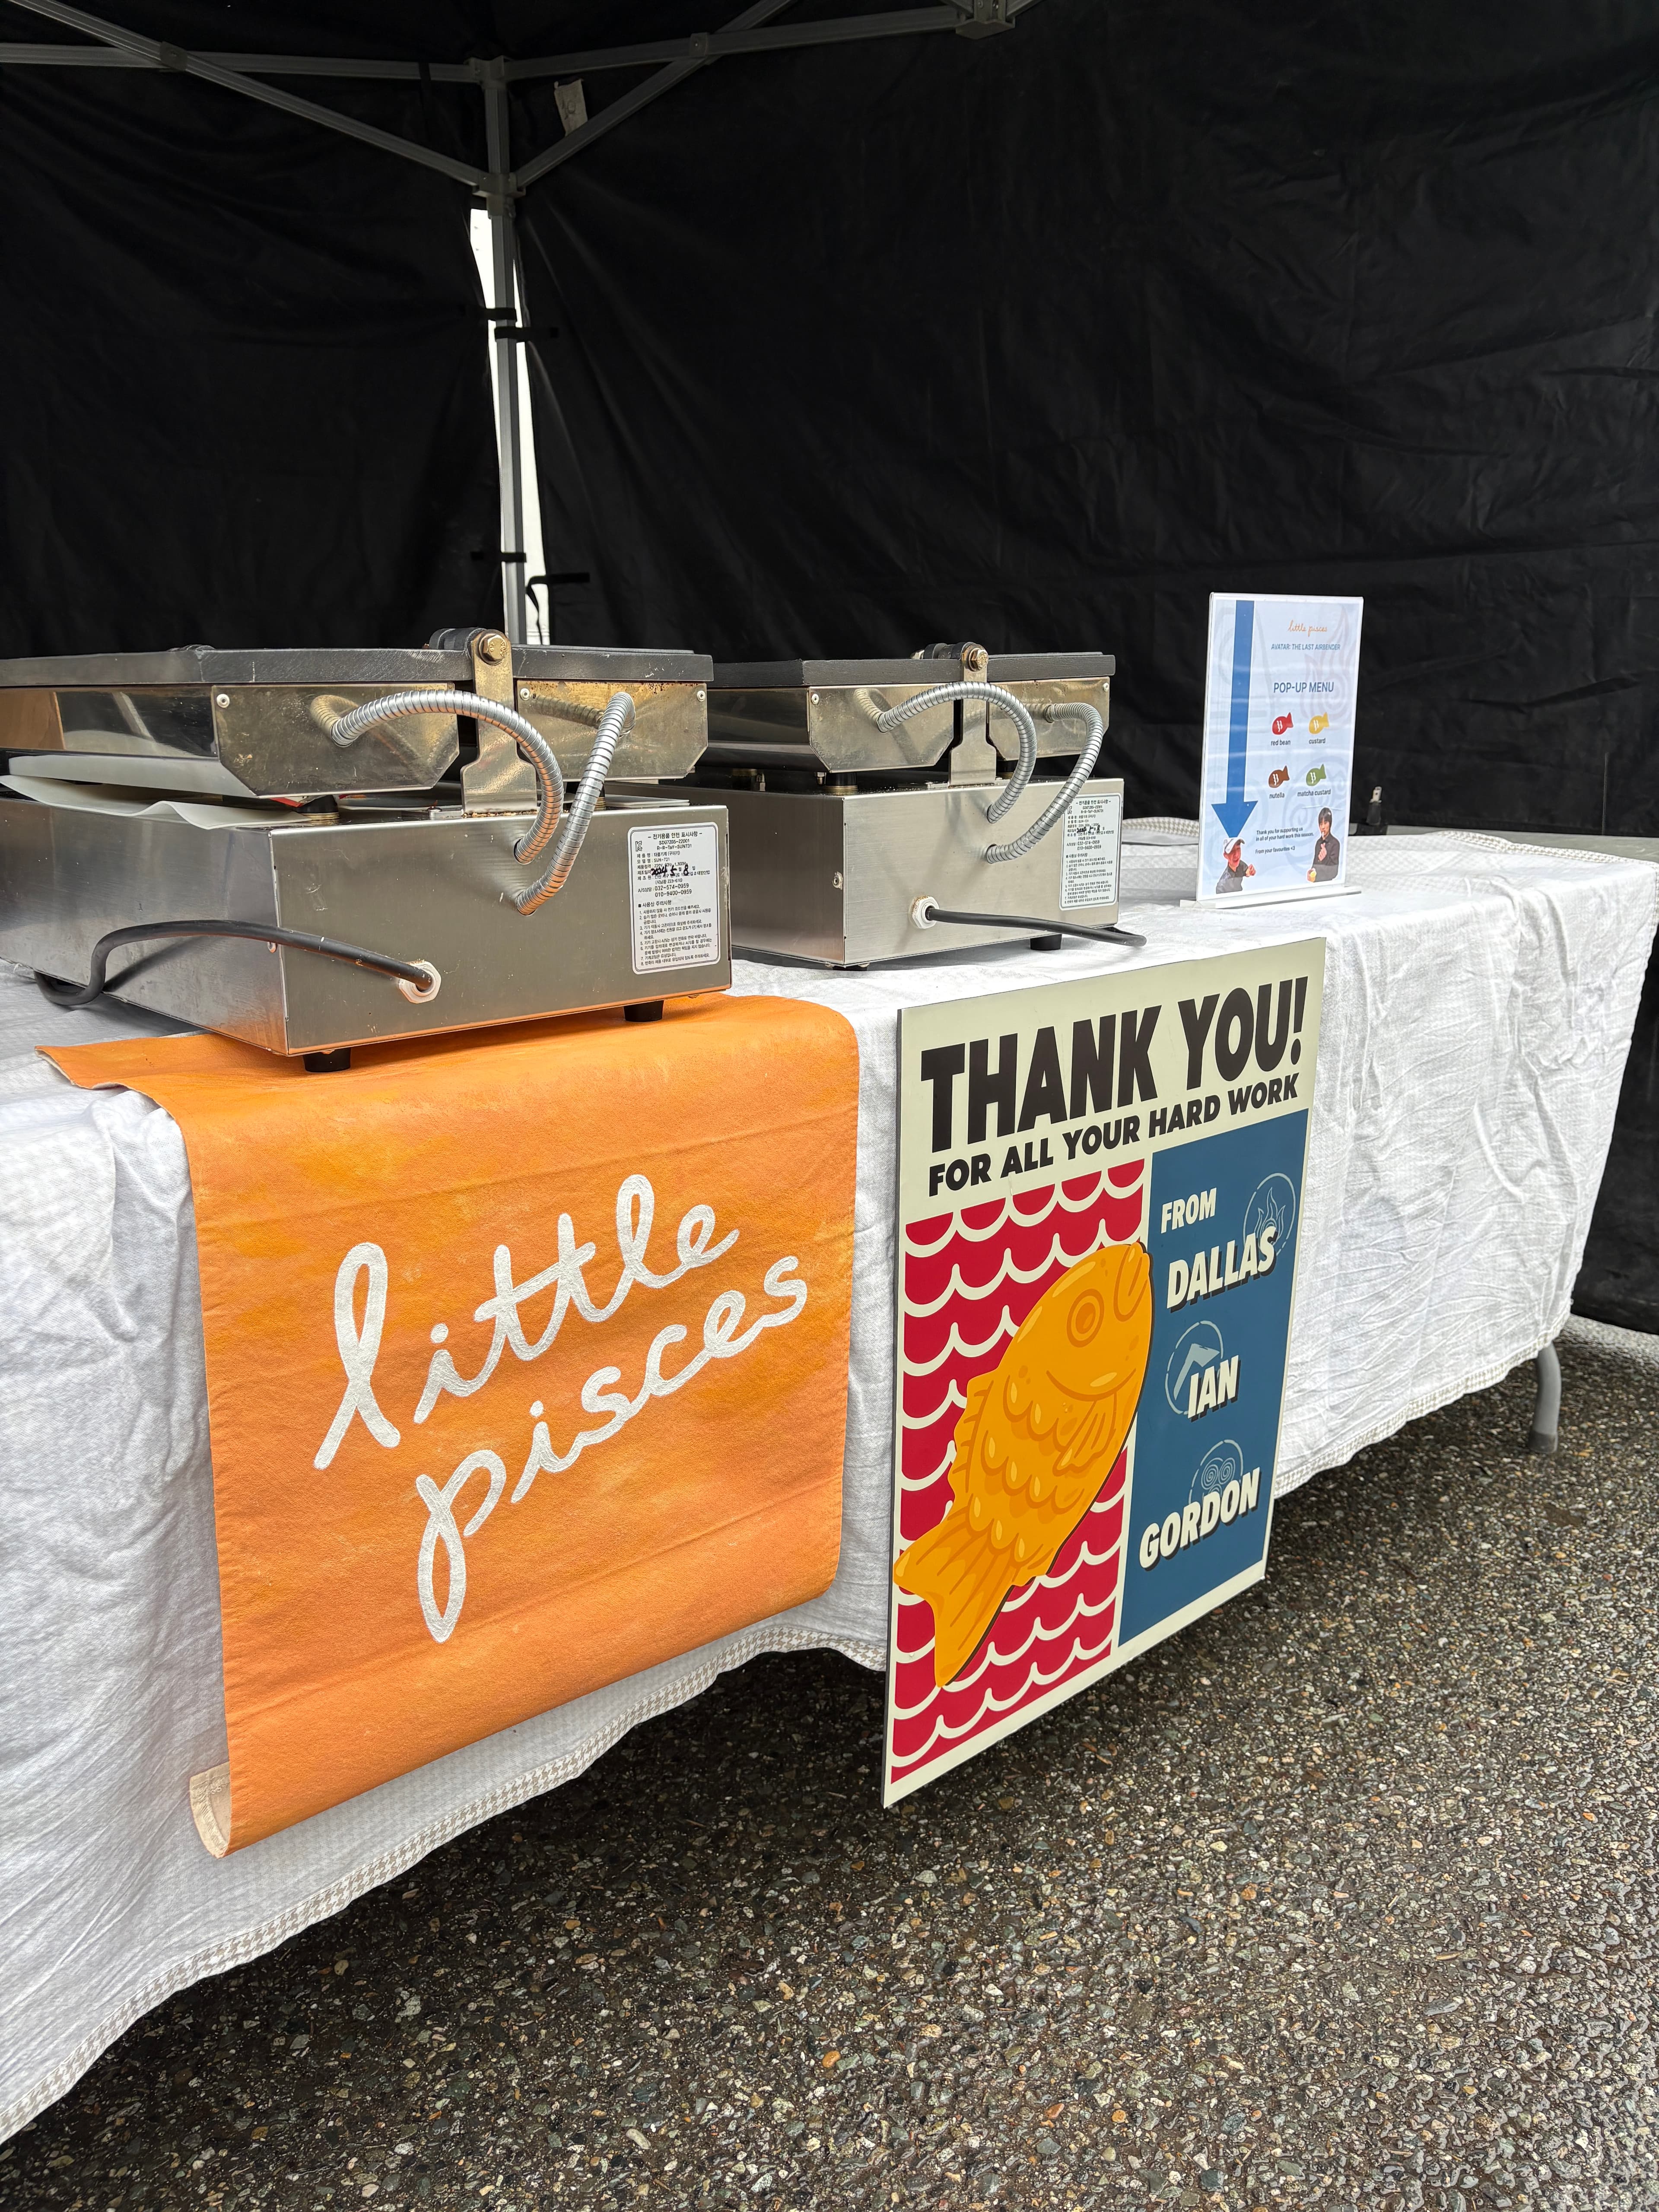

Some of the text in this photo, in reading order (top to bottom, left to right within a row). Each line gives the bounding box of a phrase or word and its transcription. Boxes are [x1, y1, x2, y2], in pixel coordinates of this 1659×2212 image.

[1288, 620, 1306, 632] little
[1274, 681, 1334, 693] POP-UP MENU
[921, 976, 1308, 1153] THANK YOU!
[928, 1073, 1300, 1196] FOR ALL YOUR HARD WORK
[1161, 1187, 1217, 1233] FROM
[1166, 1226, 1277, 1311] DALLAS
[314, 1174, 740, 1470] little
[1188, 1355, 1240, 1421] IAN
[416, 1256, 808, 1643] pisces
[1139, 1467, 1261, 1570] GORDON
